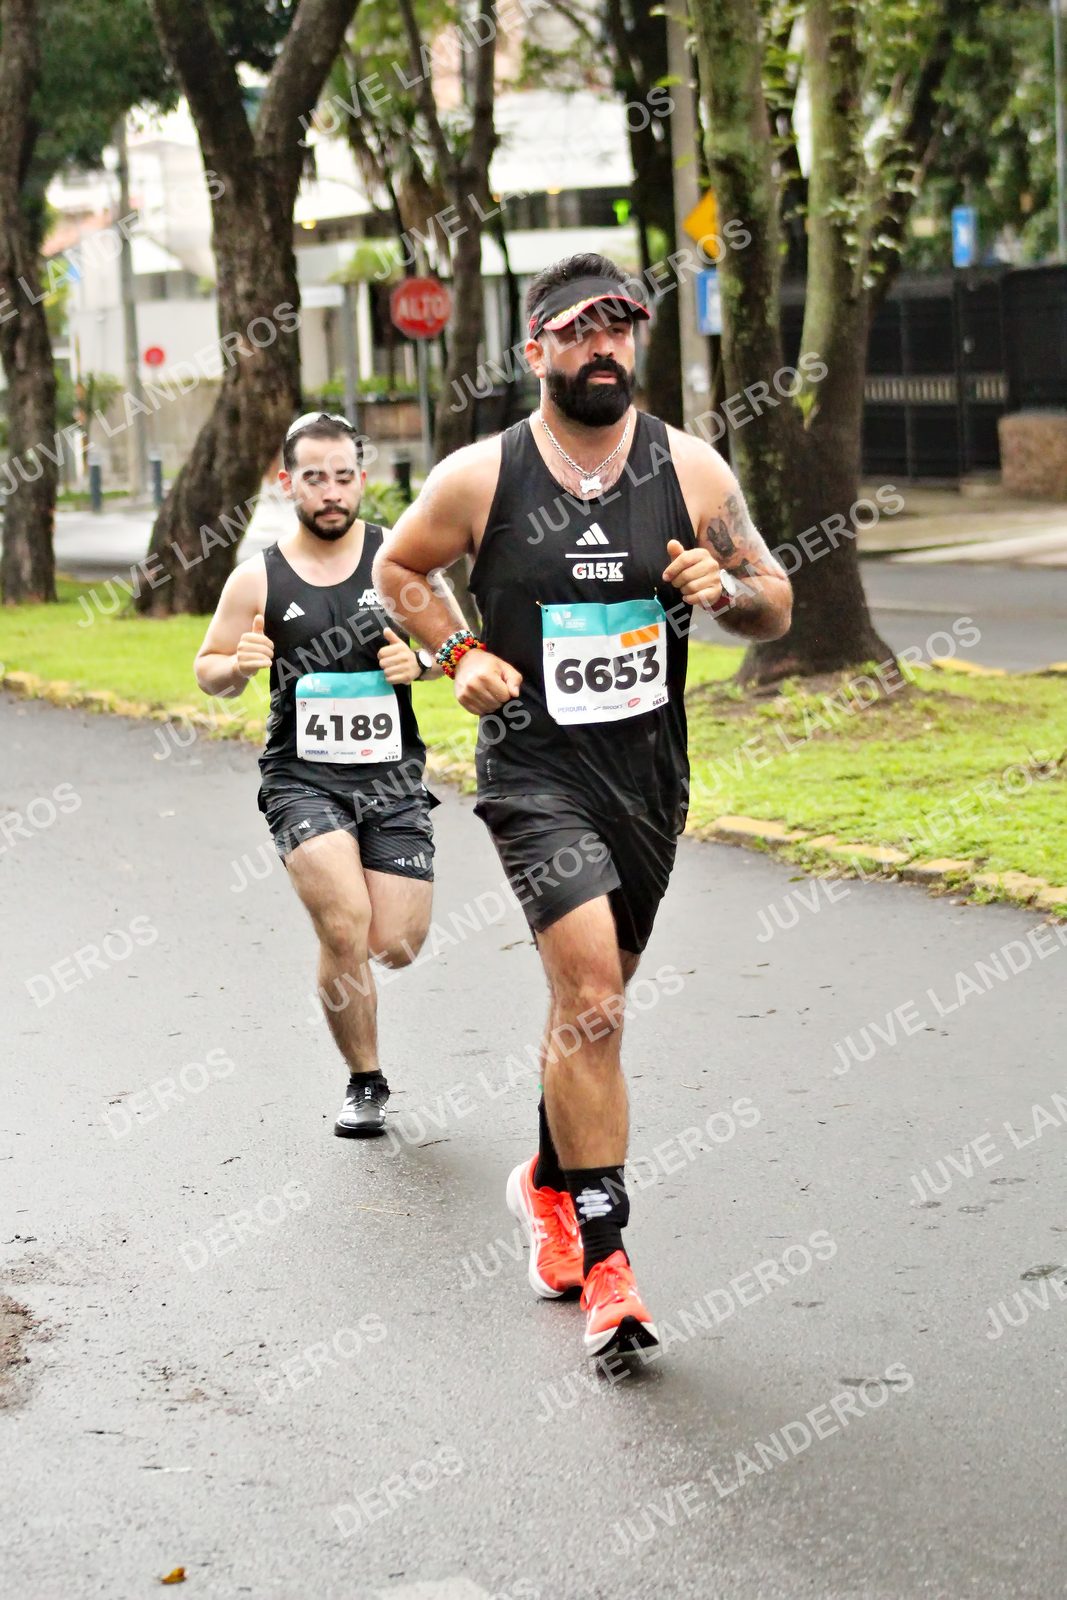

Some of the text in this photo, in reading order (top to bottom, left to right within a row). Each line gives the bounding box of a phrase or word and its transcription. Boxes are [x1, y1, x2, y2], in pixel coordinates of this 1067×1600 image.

[398, 294, 449, 321] ALTO
[572, 562, 624, 580] G15K
[555, 645, 660, 694] 6653
[305, 713, 393, 741] 4189
